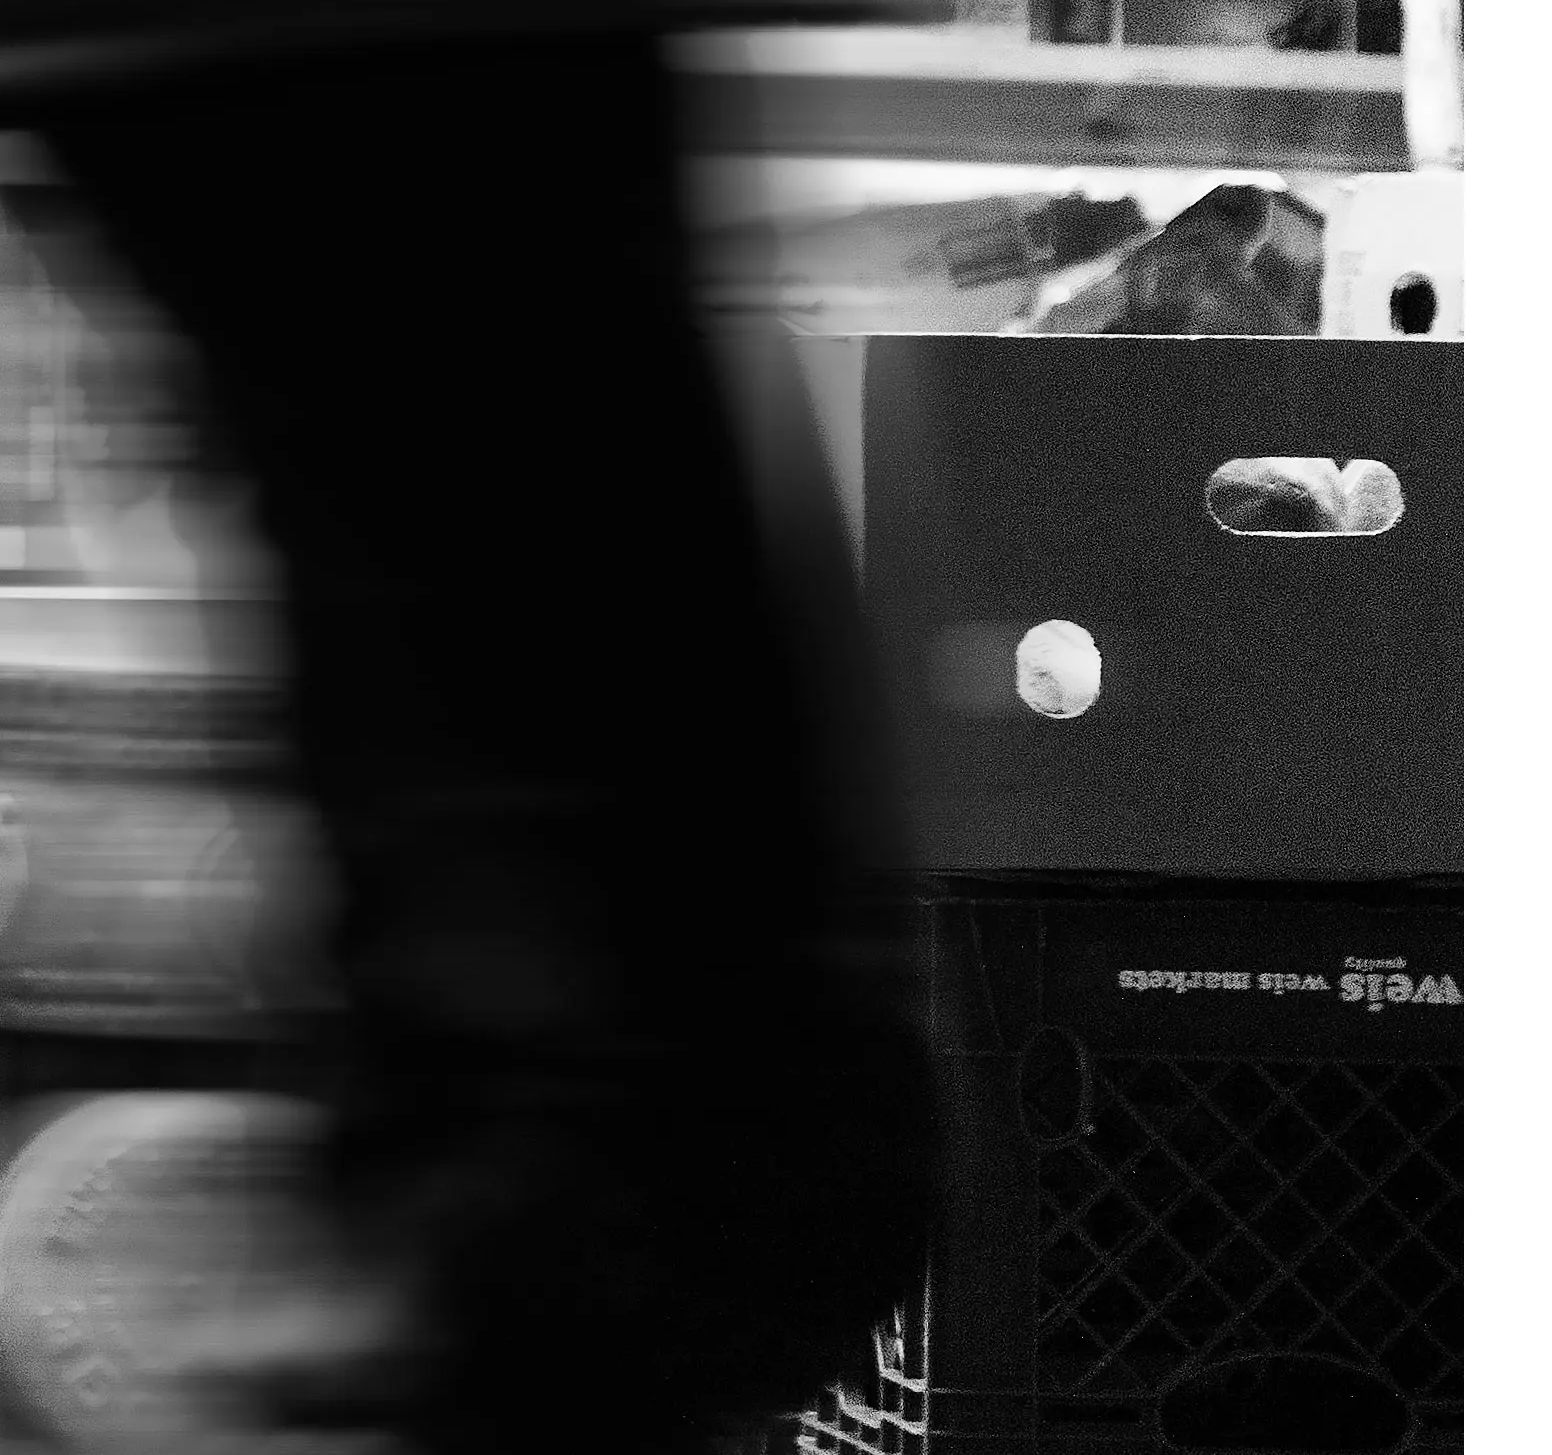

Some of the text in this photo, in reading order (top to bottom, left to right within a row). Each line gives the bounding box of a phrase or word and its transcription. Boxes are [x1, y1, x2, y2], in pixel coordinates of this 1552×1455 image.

[1117, 969, 1332, 996] weis markets
[1338, 972, 1465, 1013] weis
